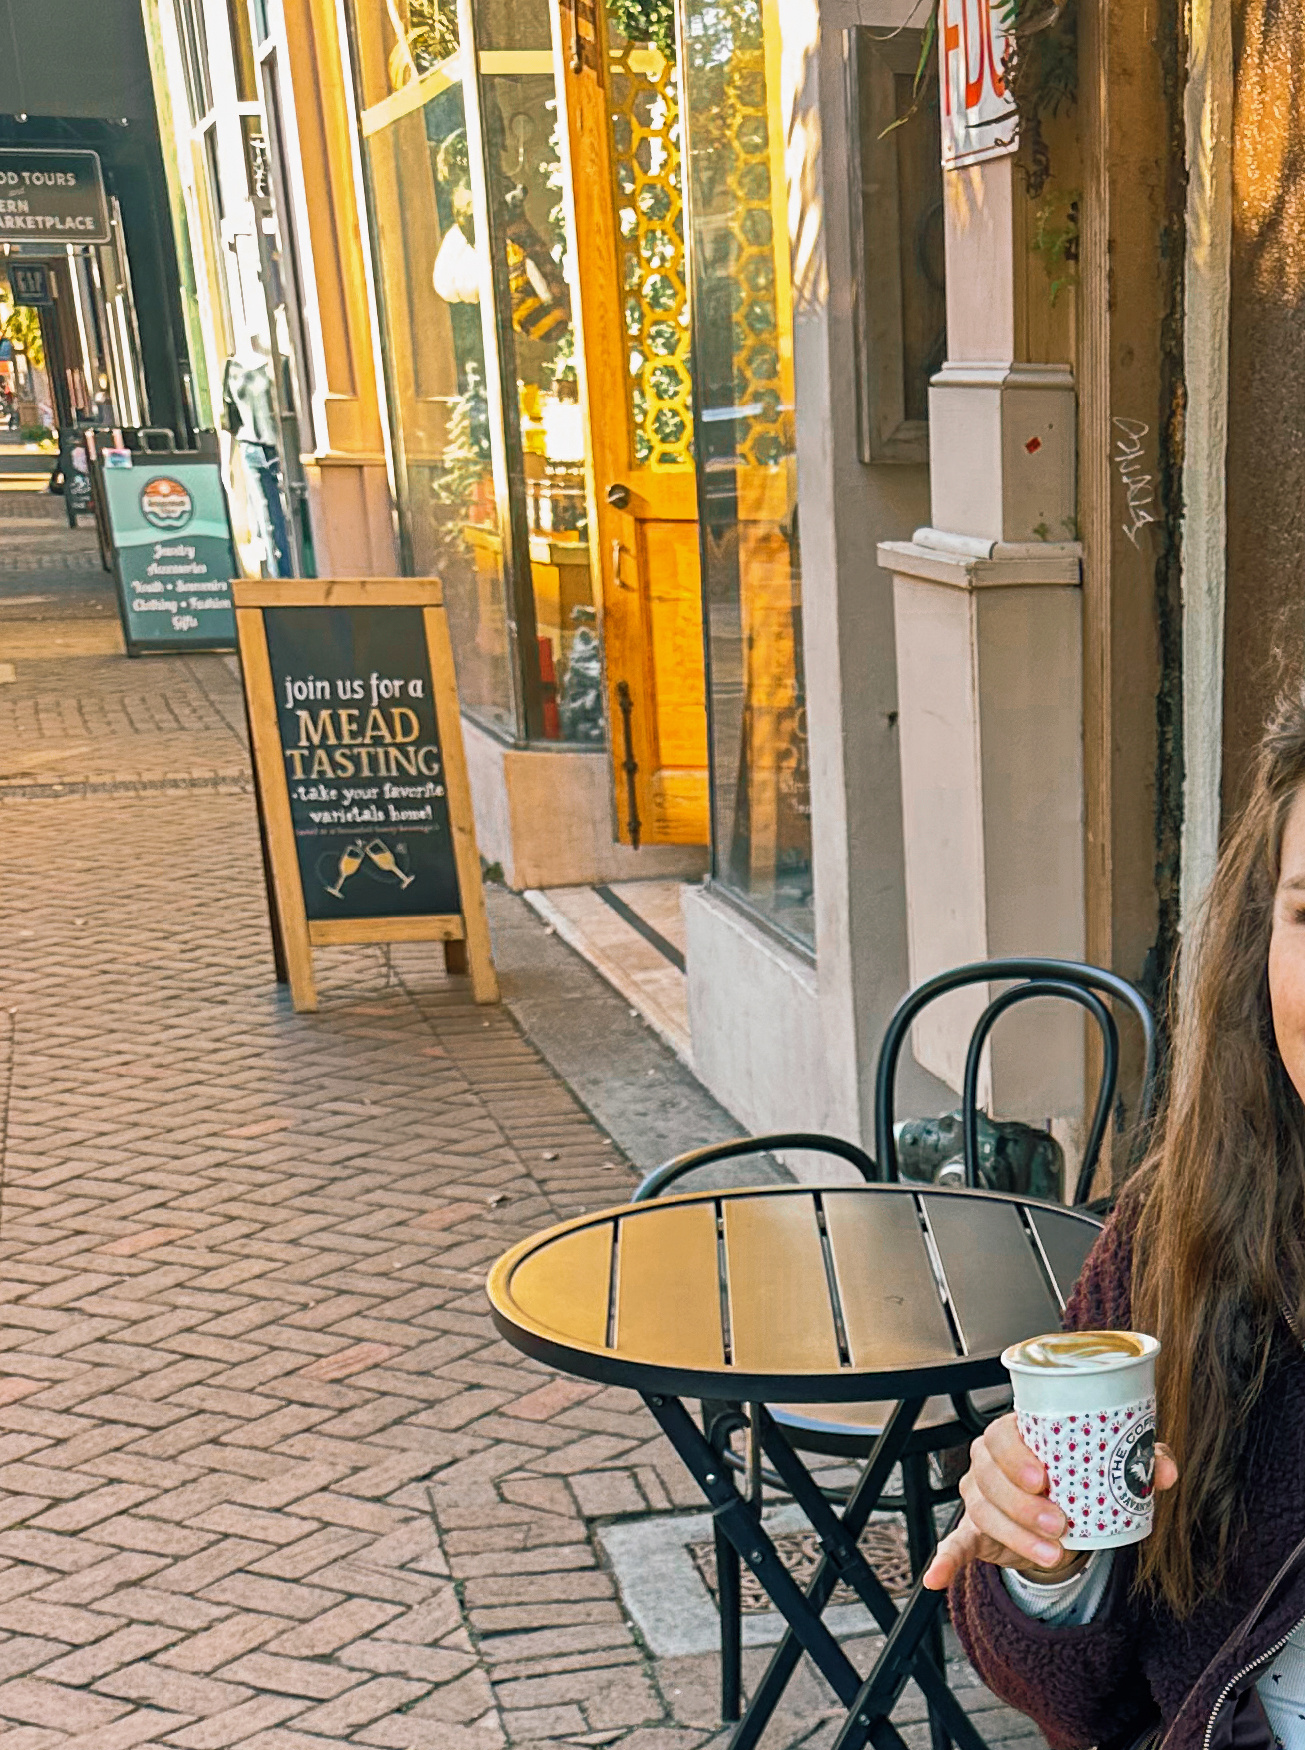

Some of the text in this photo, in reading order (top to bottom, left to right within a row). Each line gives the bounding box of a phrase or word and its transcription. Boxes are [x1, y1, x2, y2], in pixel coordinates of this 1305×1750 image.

[21, 172, 76, 186] TOURS
[285, 671, 425, 709] join us for a
[295, 707, 420, 747] MEAD
[285, 744, 440, 780] TASTING
[297, 782, 445, 806] take your favorite
[309, 804, 385, 824] varietals
[1112, 1447, 1128, 1485] THE
